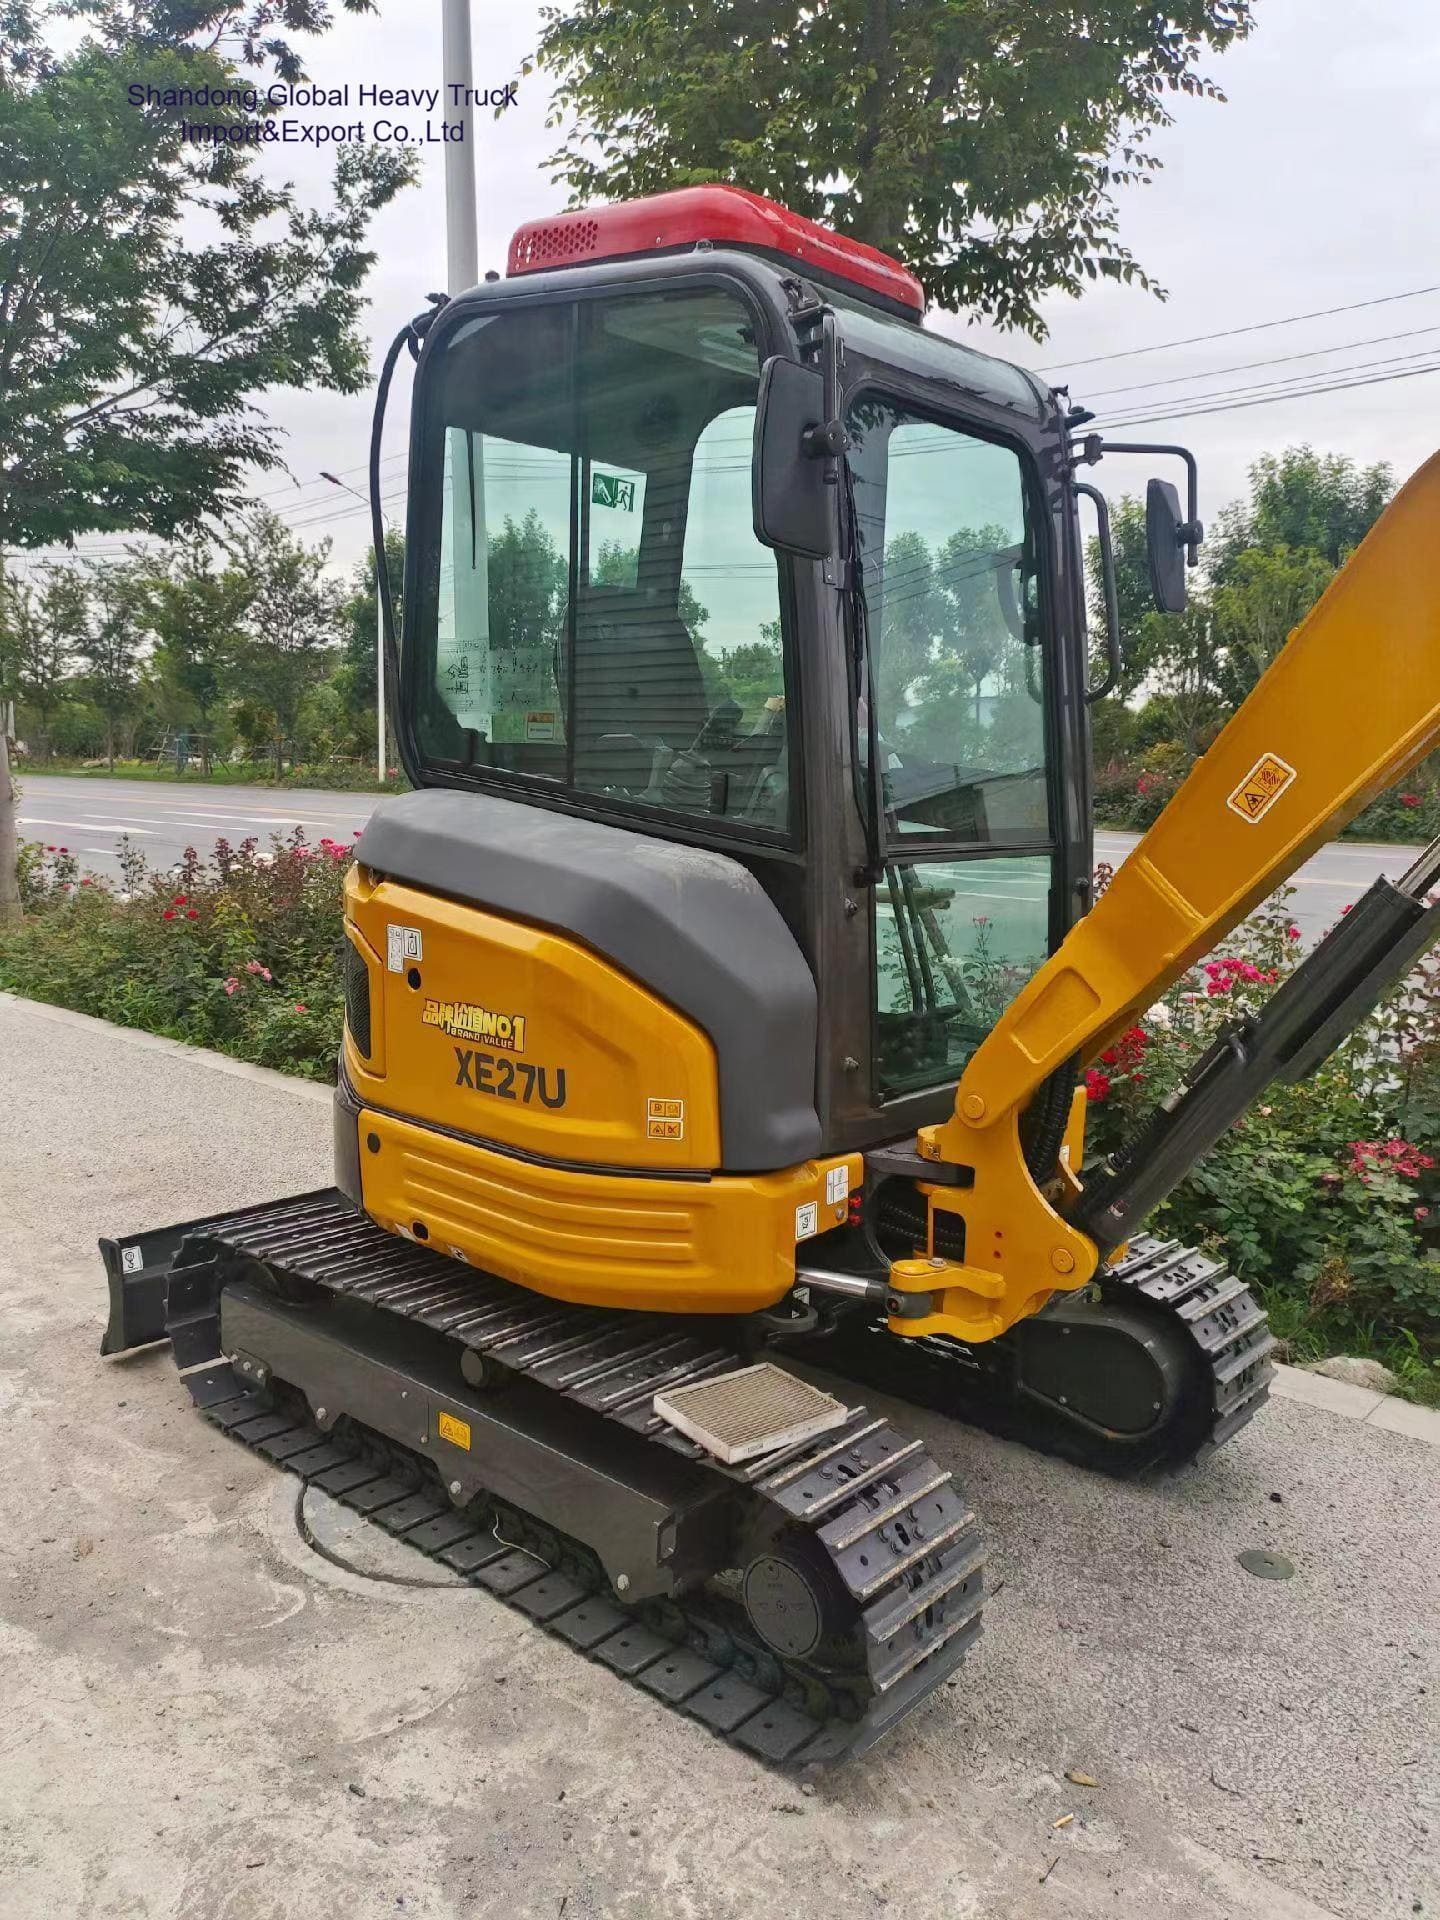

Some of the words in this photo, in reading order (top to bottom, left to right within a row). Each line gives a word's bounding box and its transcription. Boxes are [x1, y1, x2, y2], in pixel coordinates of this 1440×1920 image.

[450, 1027, 481, 1042] BRAND
[484, 1035, 513, 1049] VALUE
[454, 1046, 566, 1109] XE27U
